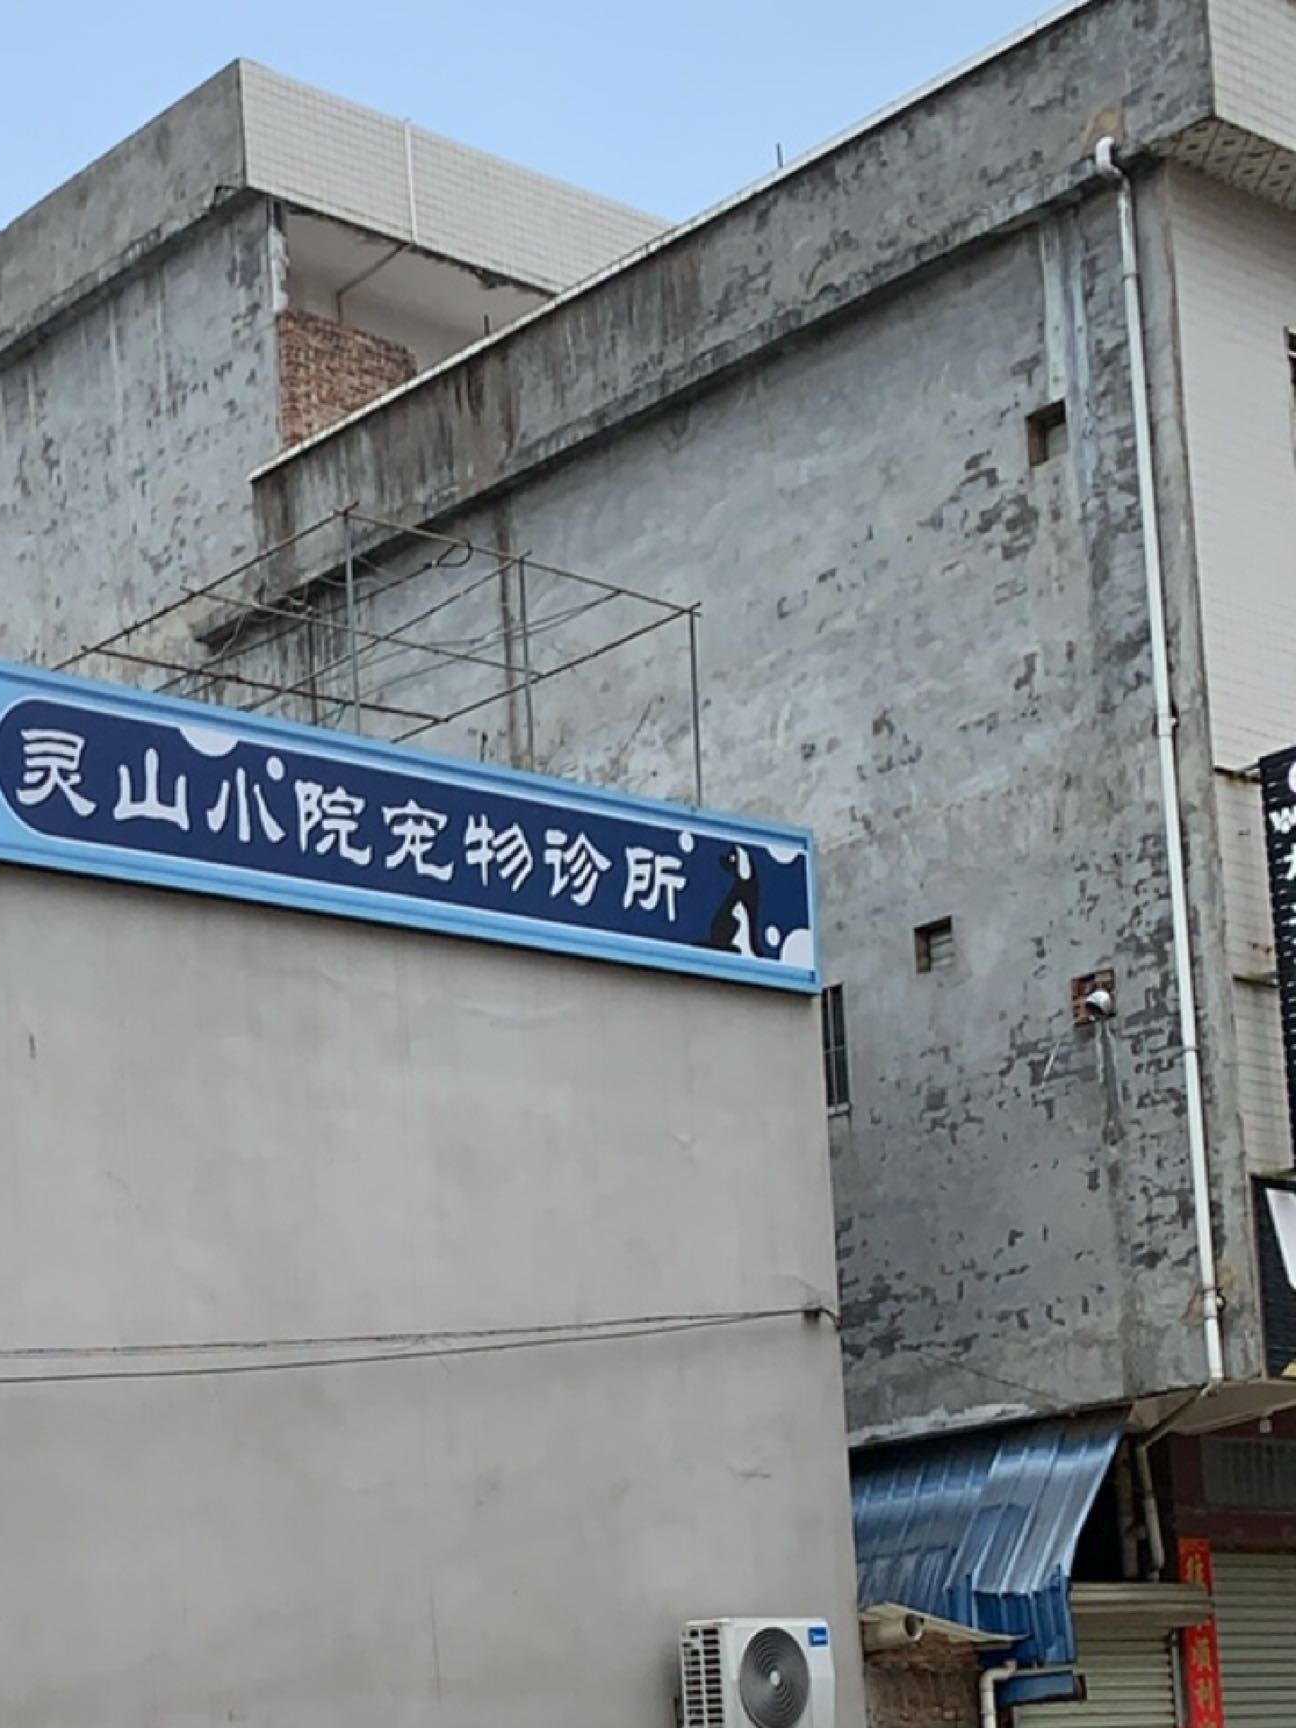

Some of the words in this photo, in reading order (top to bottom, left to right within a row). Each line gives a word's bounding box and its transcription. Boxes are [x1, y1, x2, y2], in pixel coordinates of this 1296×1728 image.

[16, 728, 688, 921] 灵山小院宠物诊所
